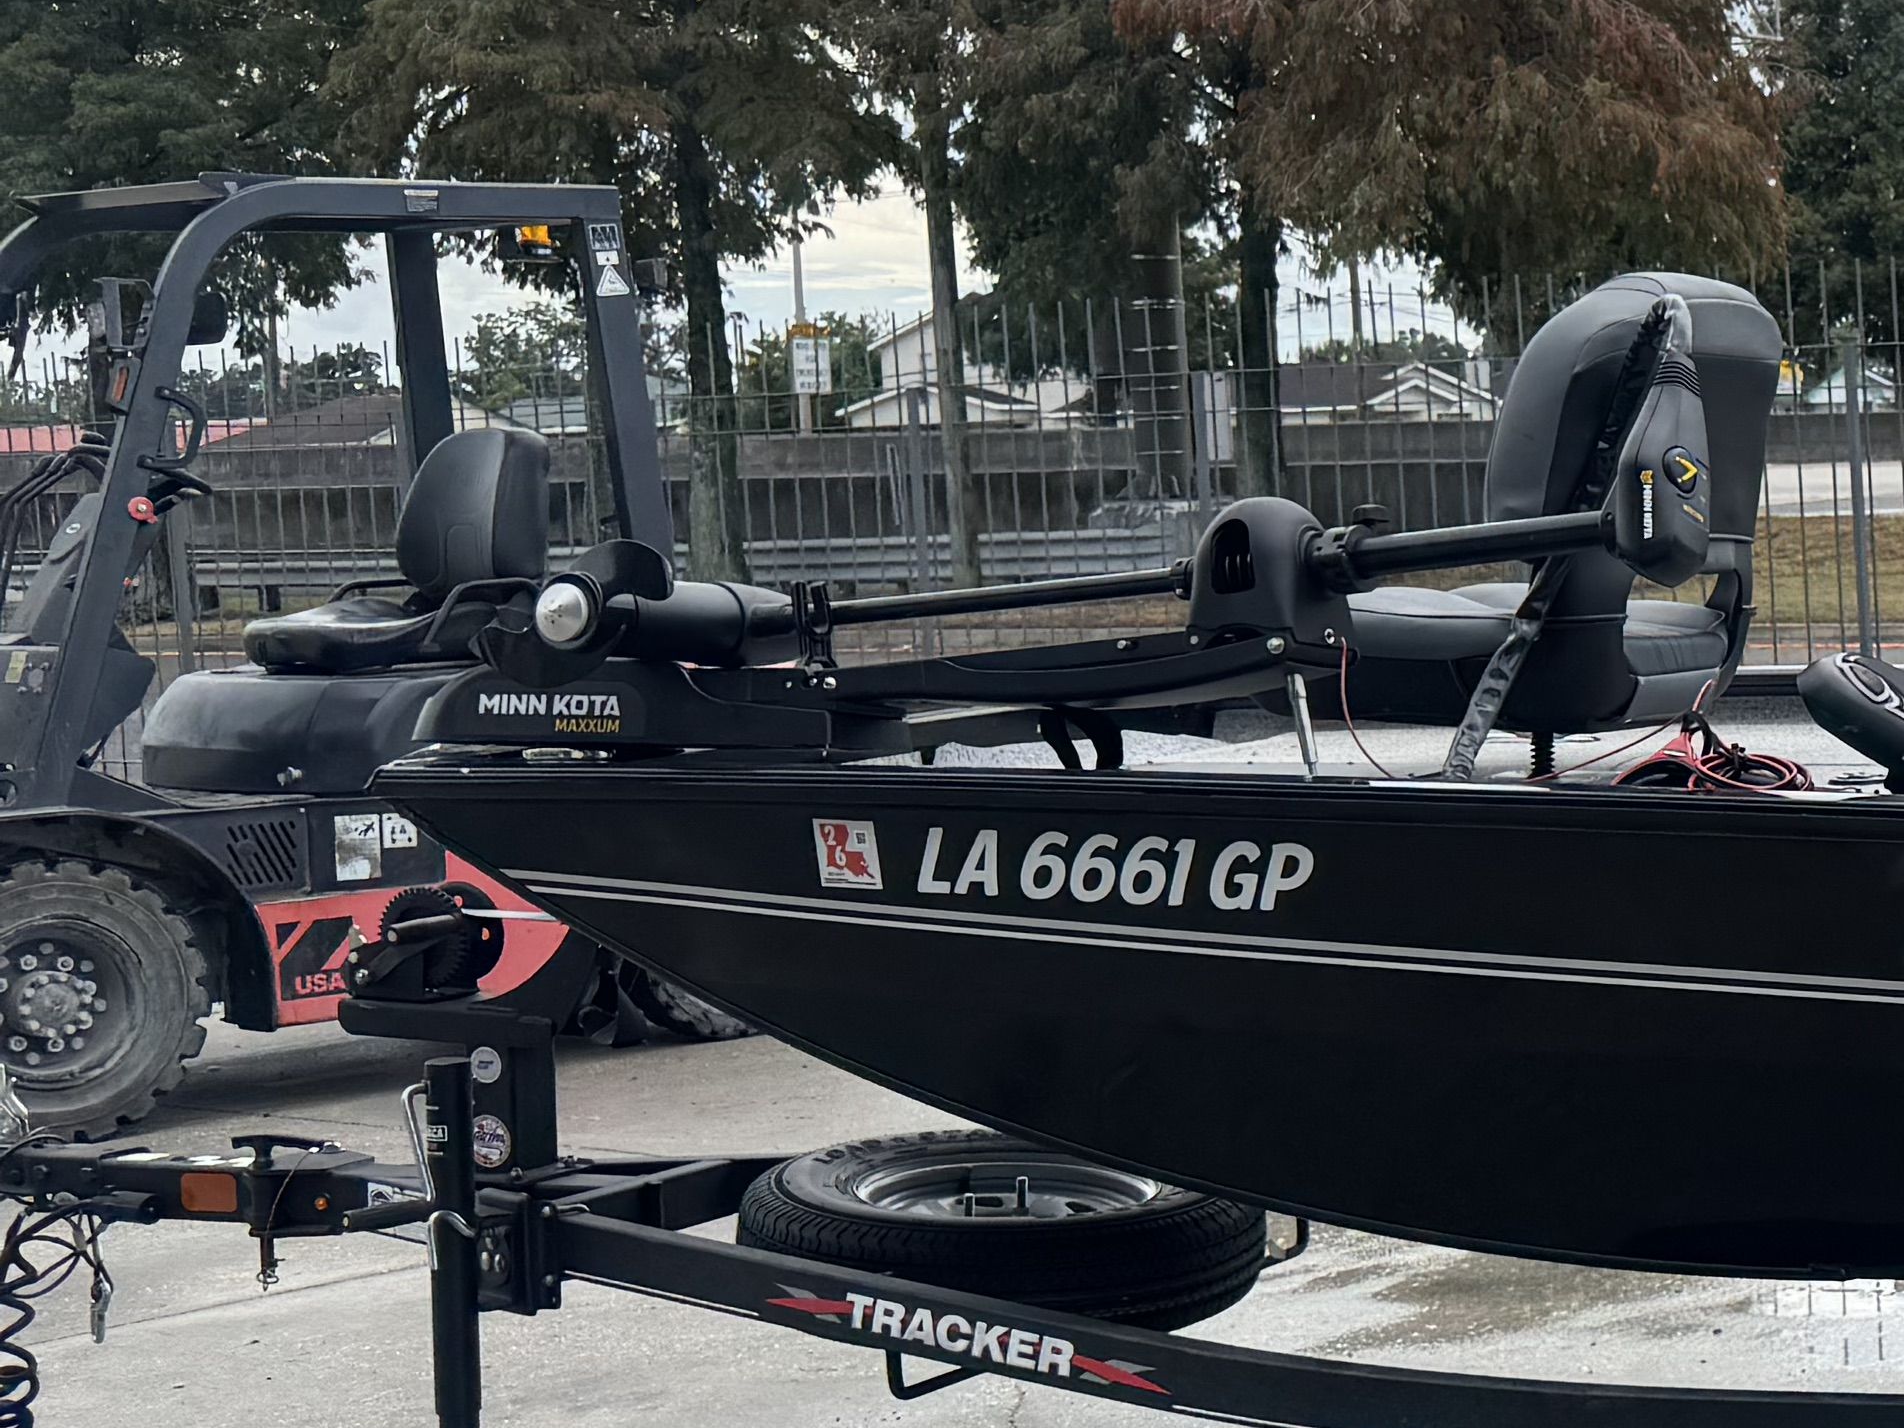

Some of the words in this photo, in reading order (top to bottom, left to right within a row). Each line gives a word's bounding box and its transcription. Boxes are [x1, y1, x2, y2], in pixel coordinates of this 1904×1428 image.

[478, 693, 547, 715] MINN
[552, 694, 620, 717] KOTA
[554, 718, 620, 733] MAXXUM
[917, 827, 999, 896] LA
[1019, 830, 1197, 907] 6661
[1208, 839, 1314, 912] GP
[295, 972, 347, 995] USA
[845, 1291, 1075, 1378] TRACKER
